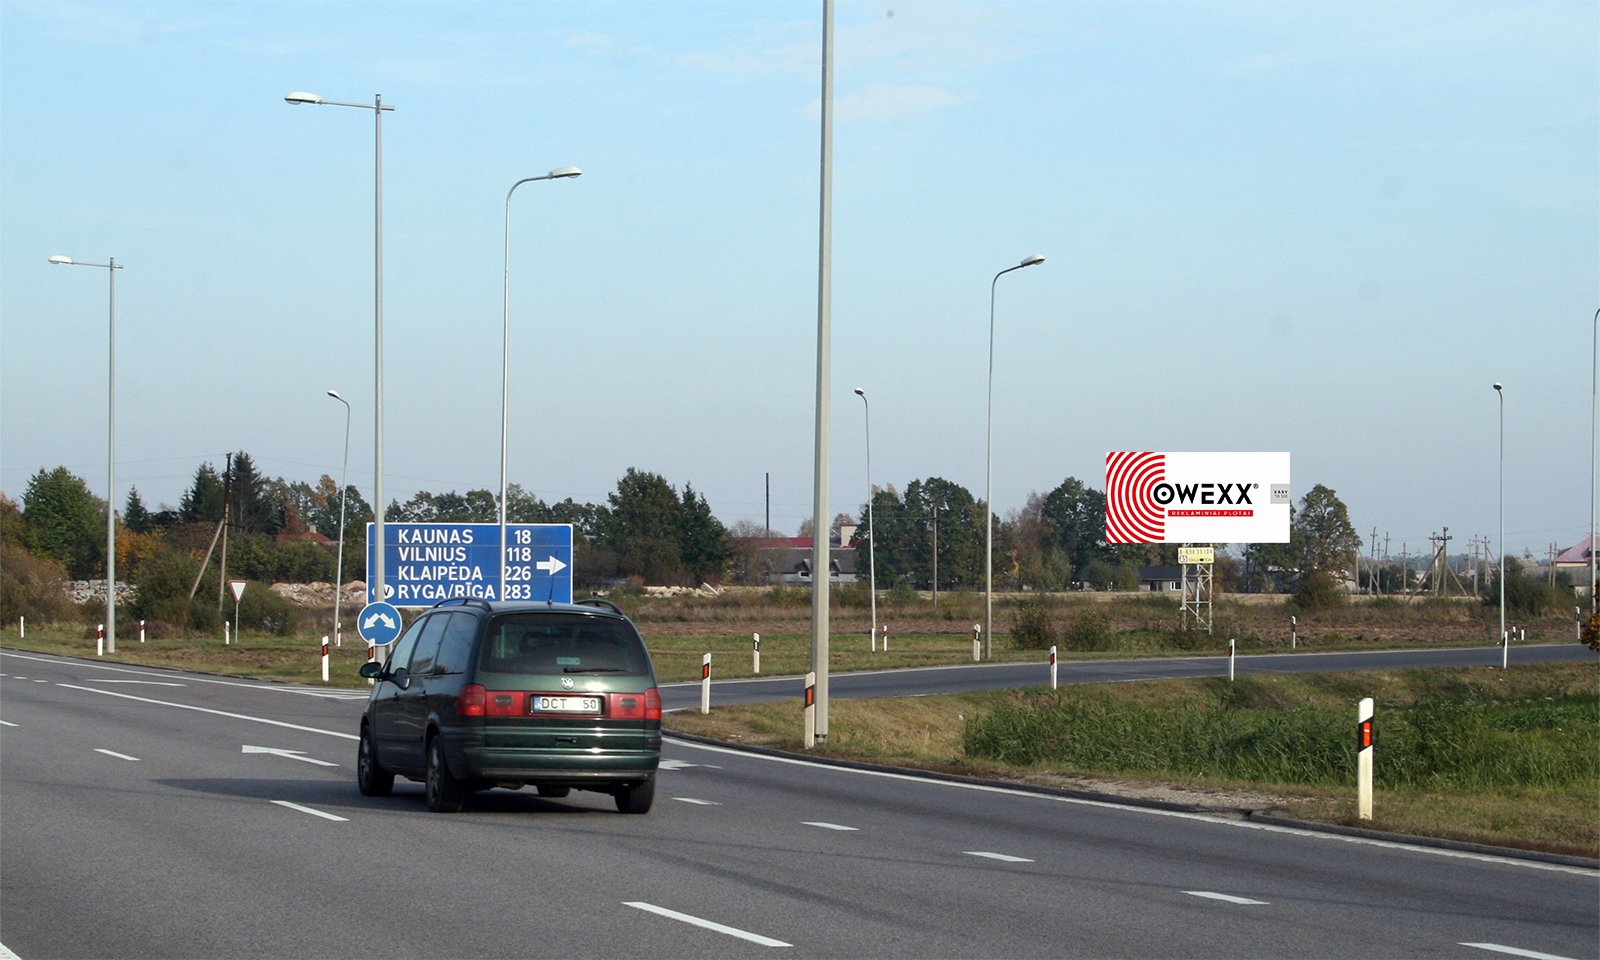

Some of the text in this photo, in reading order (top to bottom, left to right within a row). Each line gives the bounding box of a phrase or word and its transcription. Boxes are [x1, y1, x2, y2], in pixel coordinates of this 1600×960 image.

[398, 529, 532, 544] KAUNAS 18
[398, 547, 532, 562] VILNIUS 118
[398, 562, 532, 581] KLAIPĖDA 226
[398, 582, 496, 599] RYGA/RĪGA
[504, 584, 532, 599] 283
[541, 698, 567, 709] DCT
